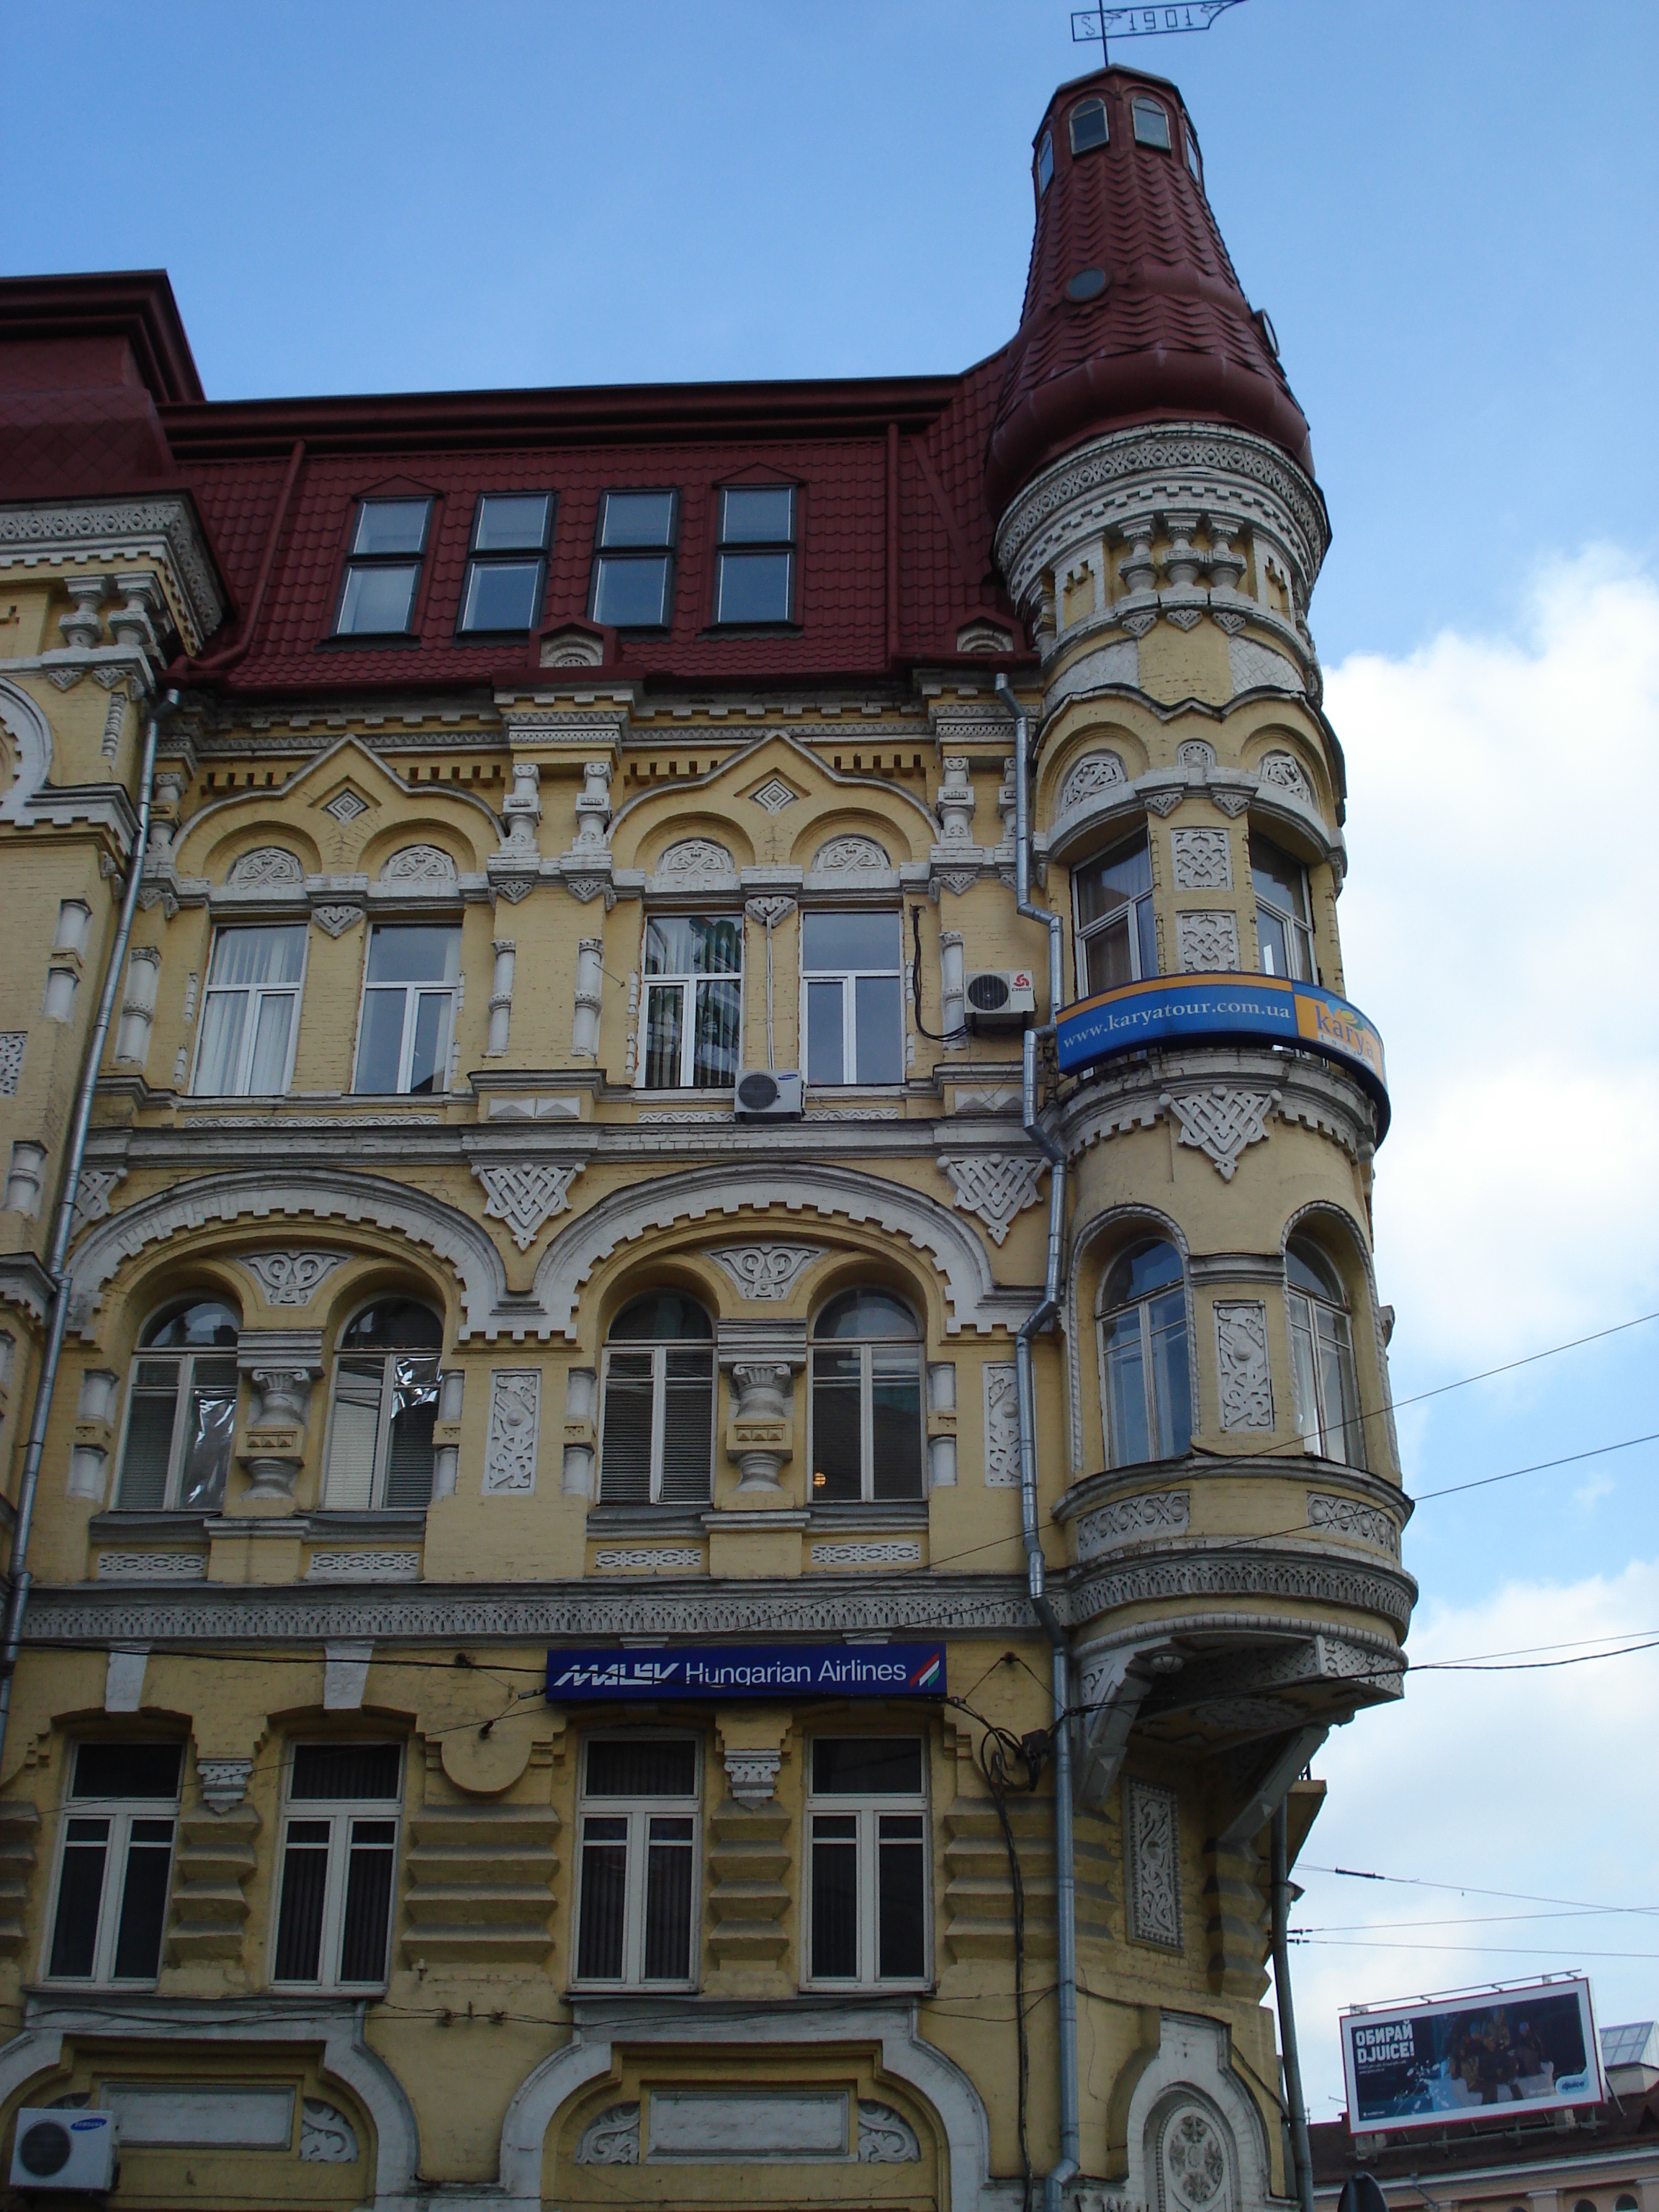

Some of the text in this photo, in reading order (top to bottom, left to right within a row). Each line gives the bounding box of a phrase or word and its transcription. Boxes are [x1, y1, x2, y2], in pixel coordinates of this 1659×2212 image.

[1129, 7, 1193, 30] 1901
[1063, 1002, 1291, 1048] www.karyatour.com.ua
[1315, 1004, 1375, 1062] karya
[685, 1661, 811, 1686] Hungarian
[817, 1660, 907, 1682] Airlines
[1355, 2019, 1413, 2046] ОБИРАЙ
[1357, 2041, 1415, 2064] DJUICE!
